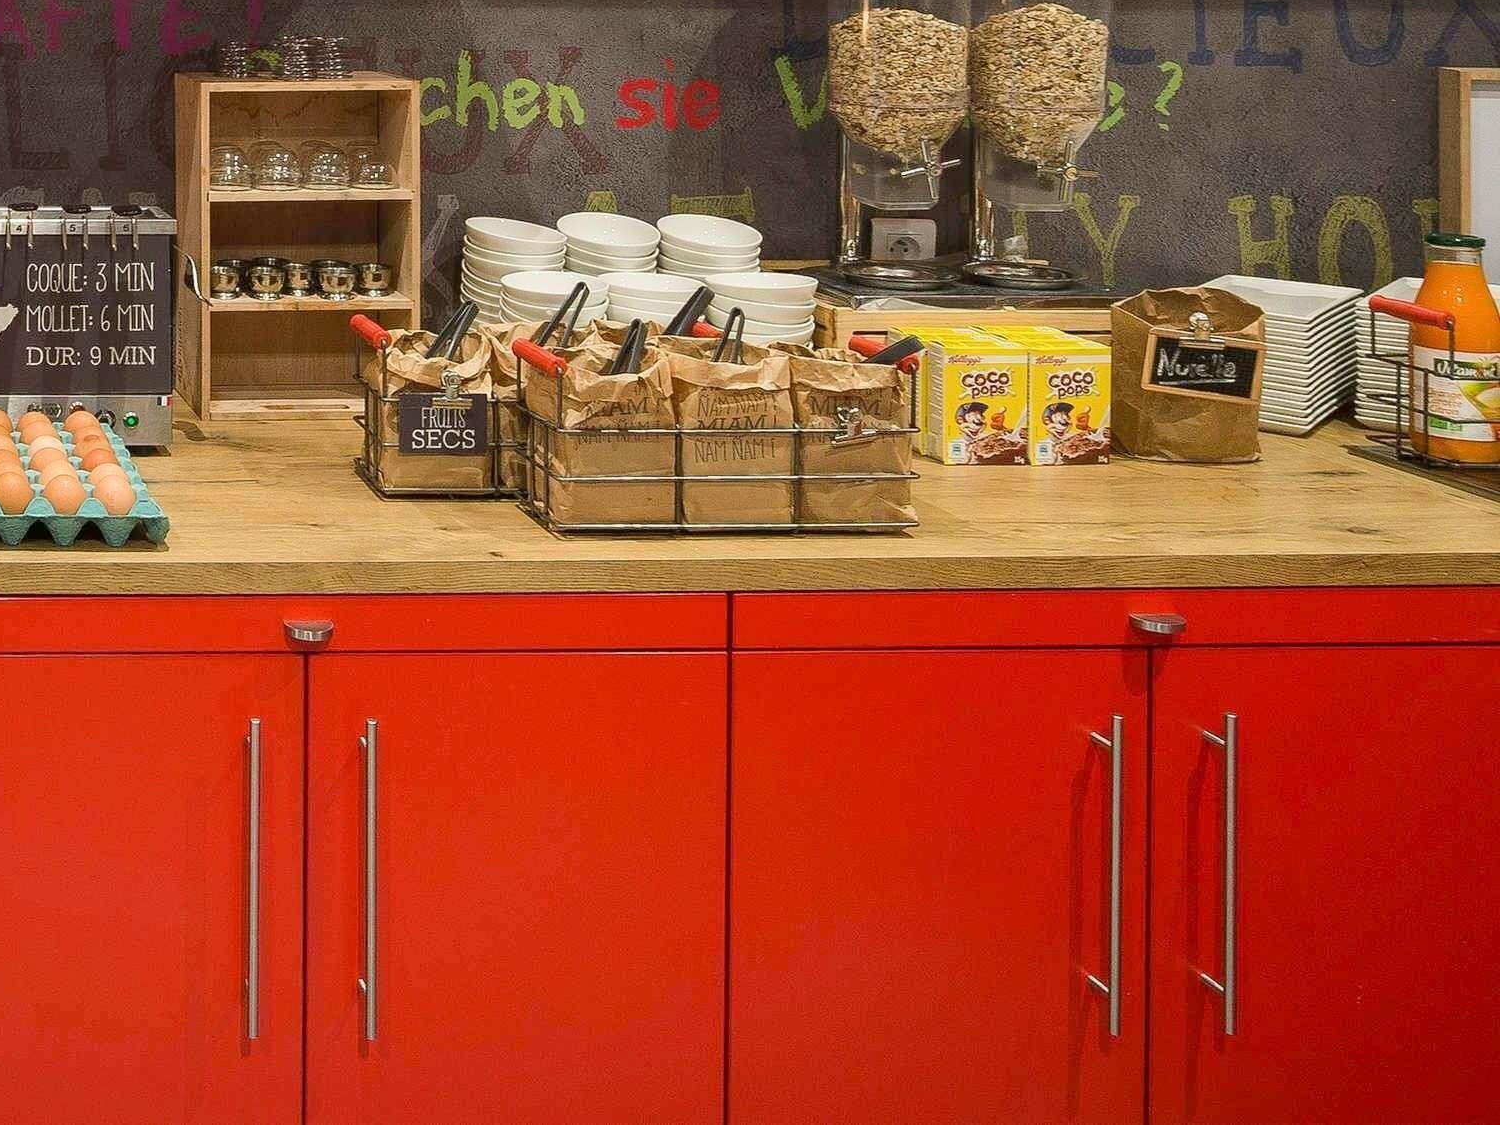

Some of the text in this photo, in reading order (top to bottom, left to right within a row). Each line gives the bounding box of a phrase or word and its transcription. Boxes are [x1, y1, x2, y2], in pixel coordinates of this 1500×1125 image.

[614, 58, 722, 131] sie
[25, 262, 155, 293] COQUE: 3 MIN
[25, 304, 155, 333] MOLLET: 6 MIN
[25, 345, 156, 366] DUR: 9 MIN
[421, 406, 467, 429] FRUITS
[411, 428, 476, 451] SECS
